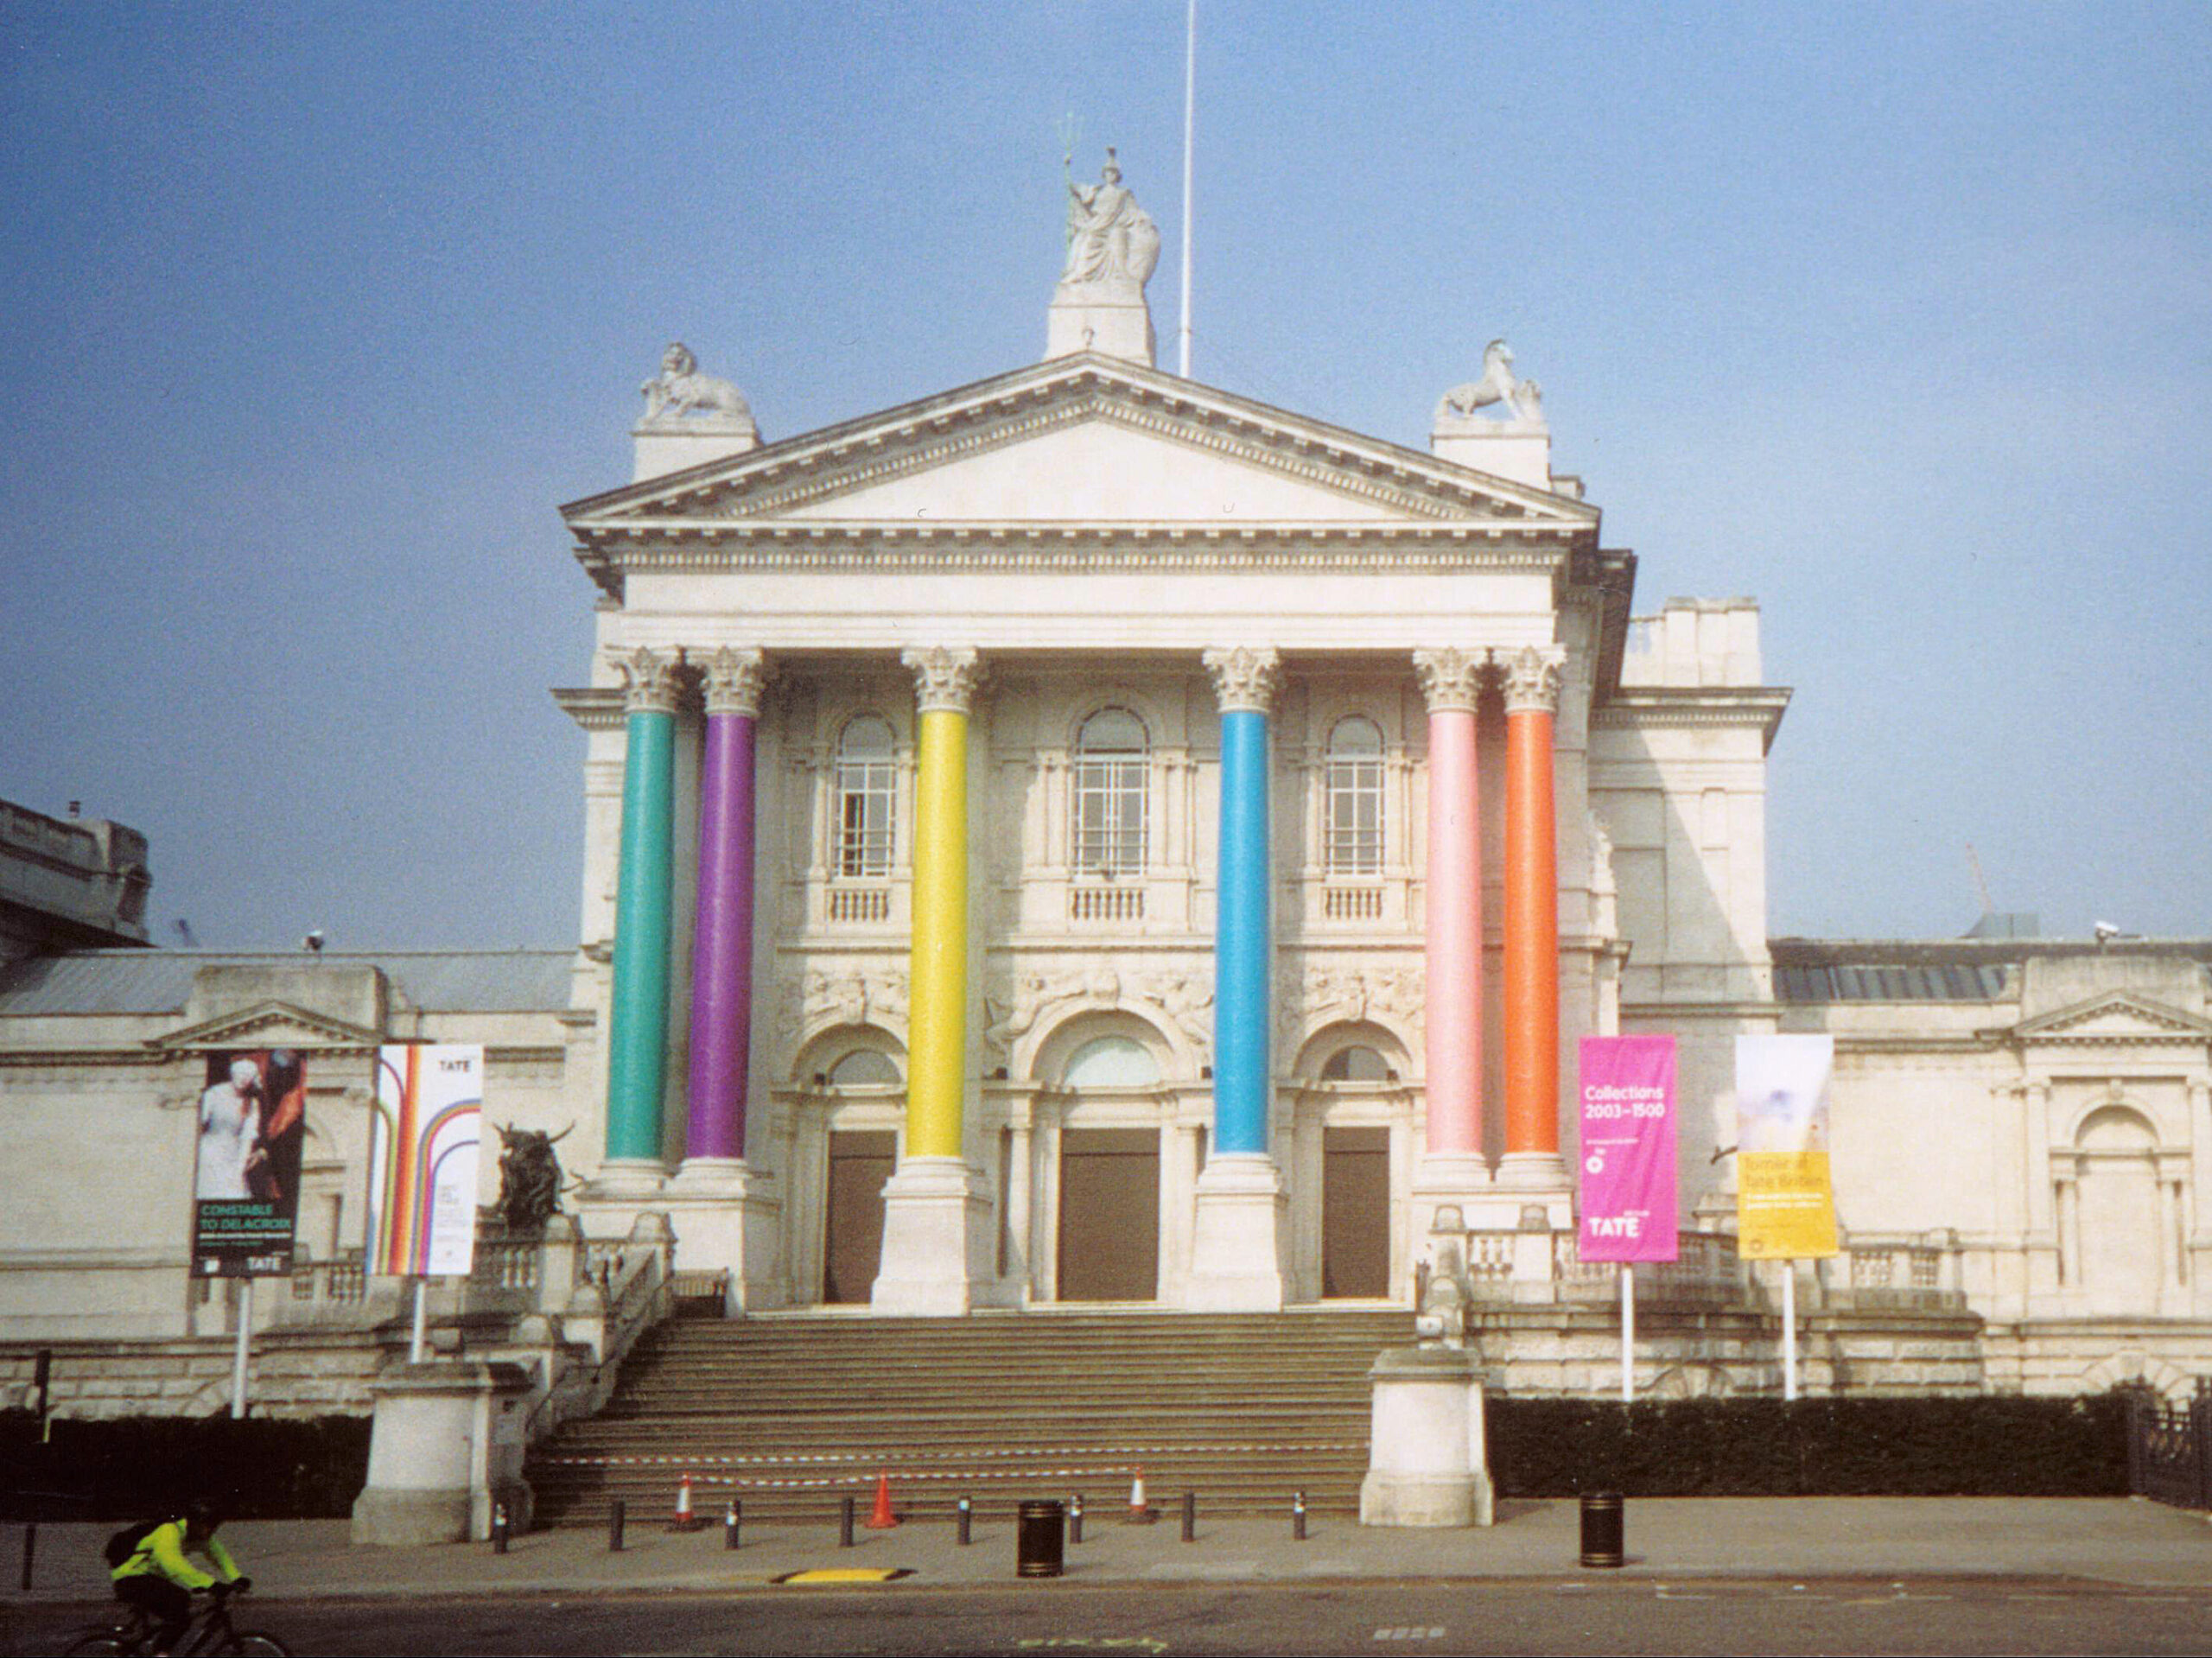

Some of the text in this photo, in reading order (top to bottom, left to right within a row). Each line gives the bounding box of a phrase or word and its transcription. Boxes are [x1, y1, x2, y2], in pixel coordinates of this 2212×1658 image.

[439, 1059, 472, 1072] TATE
[1586, 1084, 1664, 1100] Collections
[201, 1204, 273, 1216] CONSTABLE
[200, 1218, 291, 1229] TO DELACROIX
[1588, 1217, 1640, 1237] TATE
[246, 1256, 281, 1271] TATE
